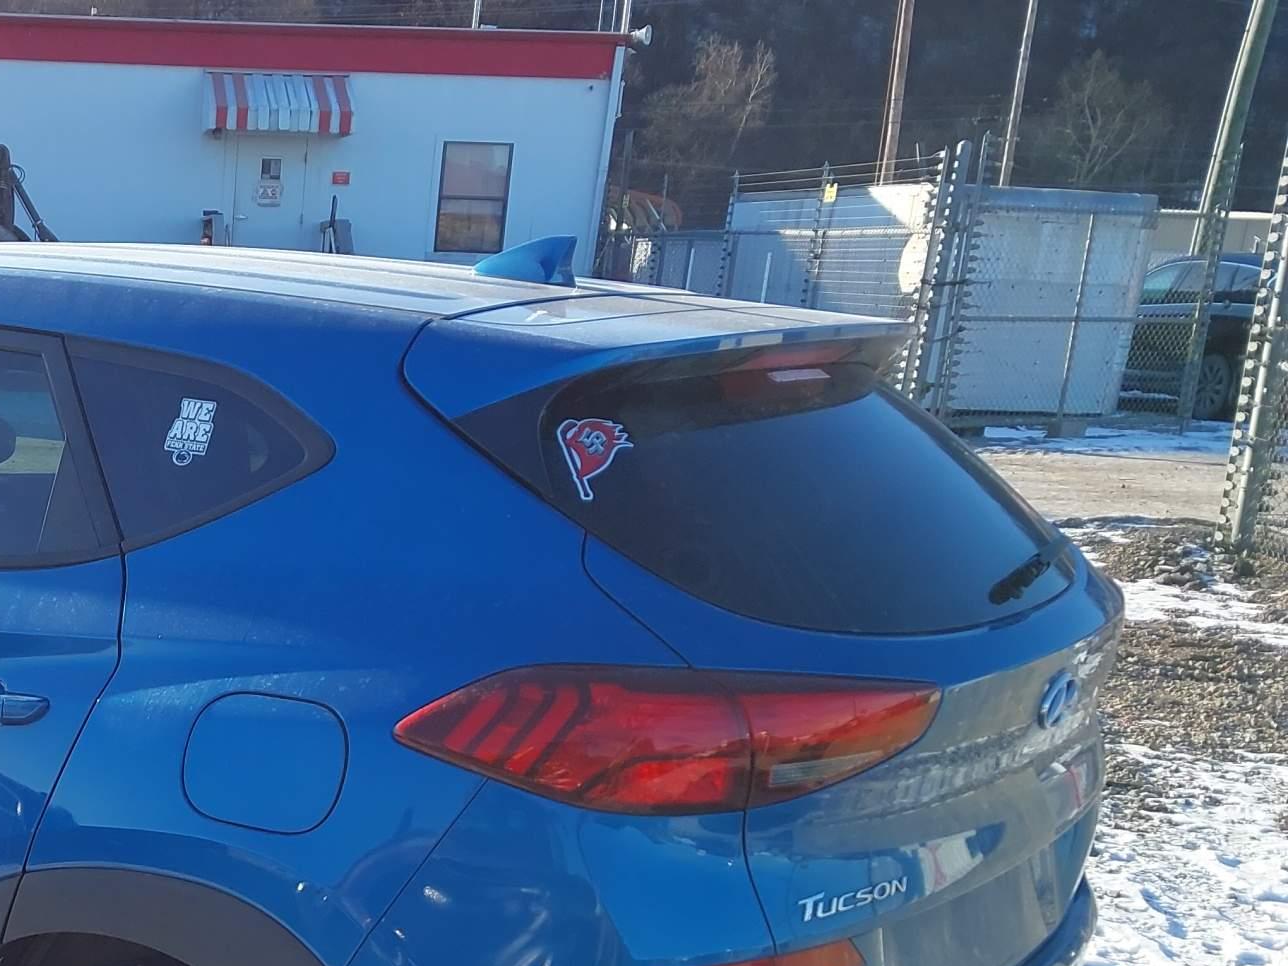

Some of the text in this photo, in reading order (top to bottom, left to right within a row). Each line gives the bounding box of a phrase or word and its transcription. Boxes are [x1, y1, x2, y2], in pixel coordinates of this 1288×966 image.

[180, 400, 215, 421] WE
[168, 420, 212, 443] ARE
[184, 442, 206, 452] STATE
